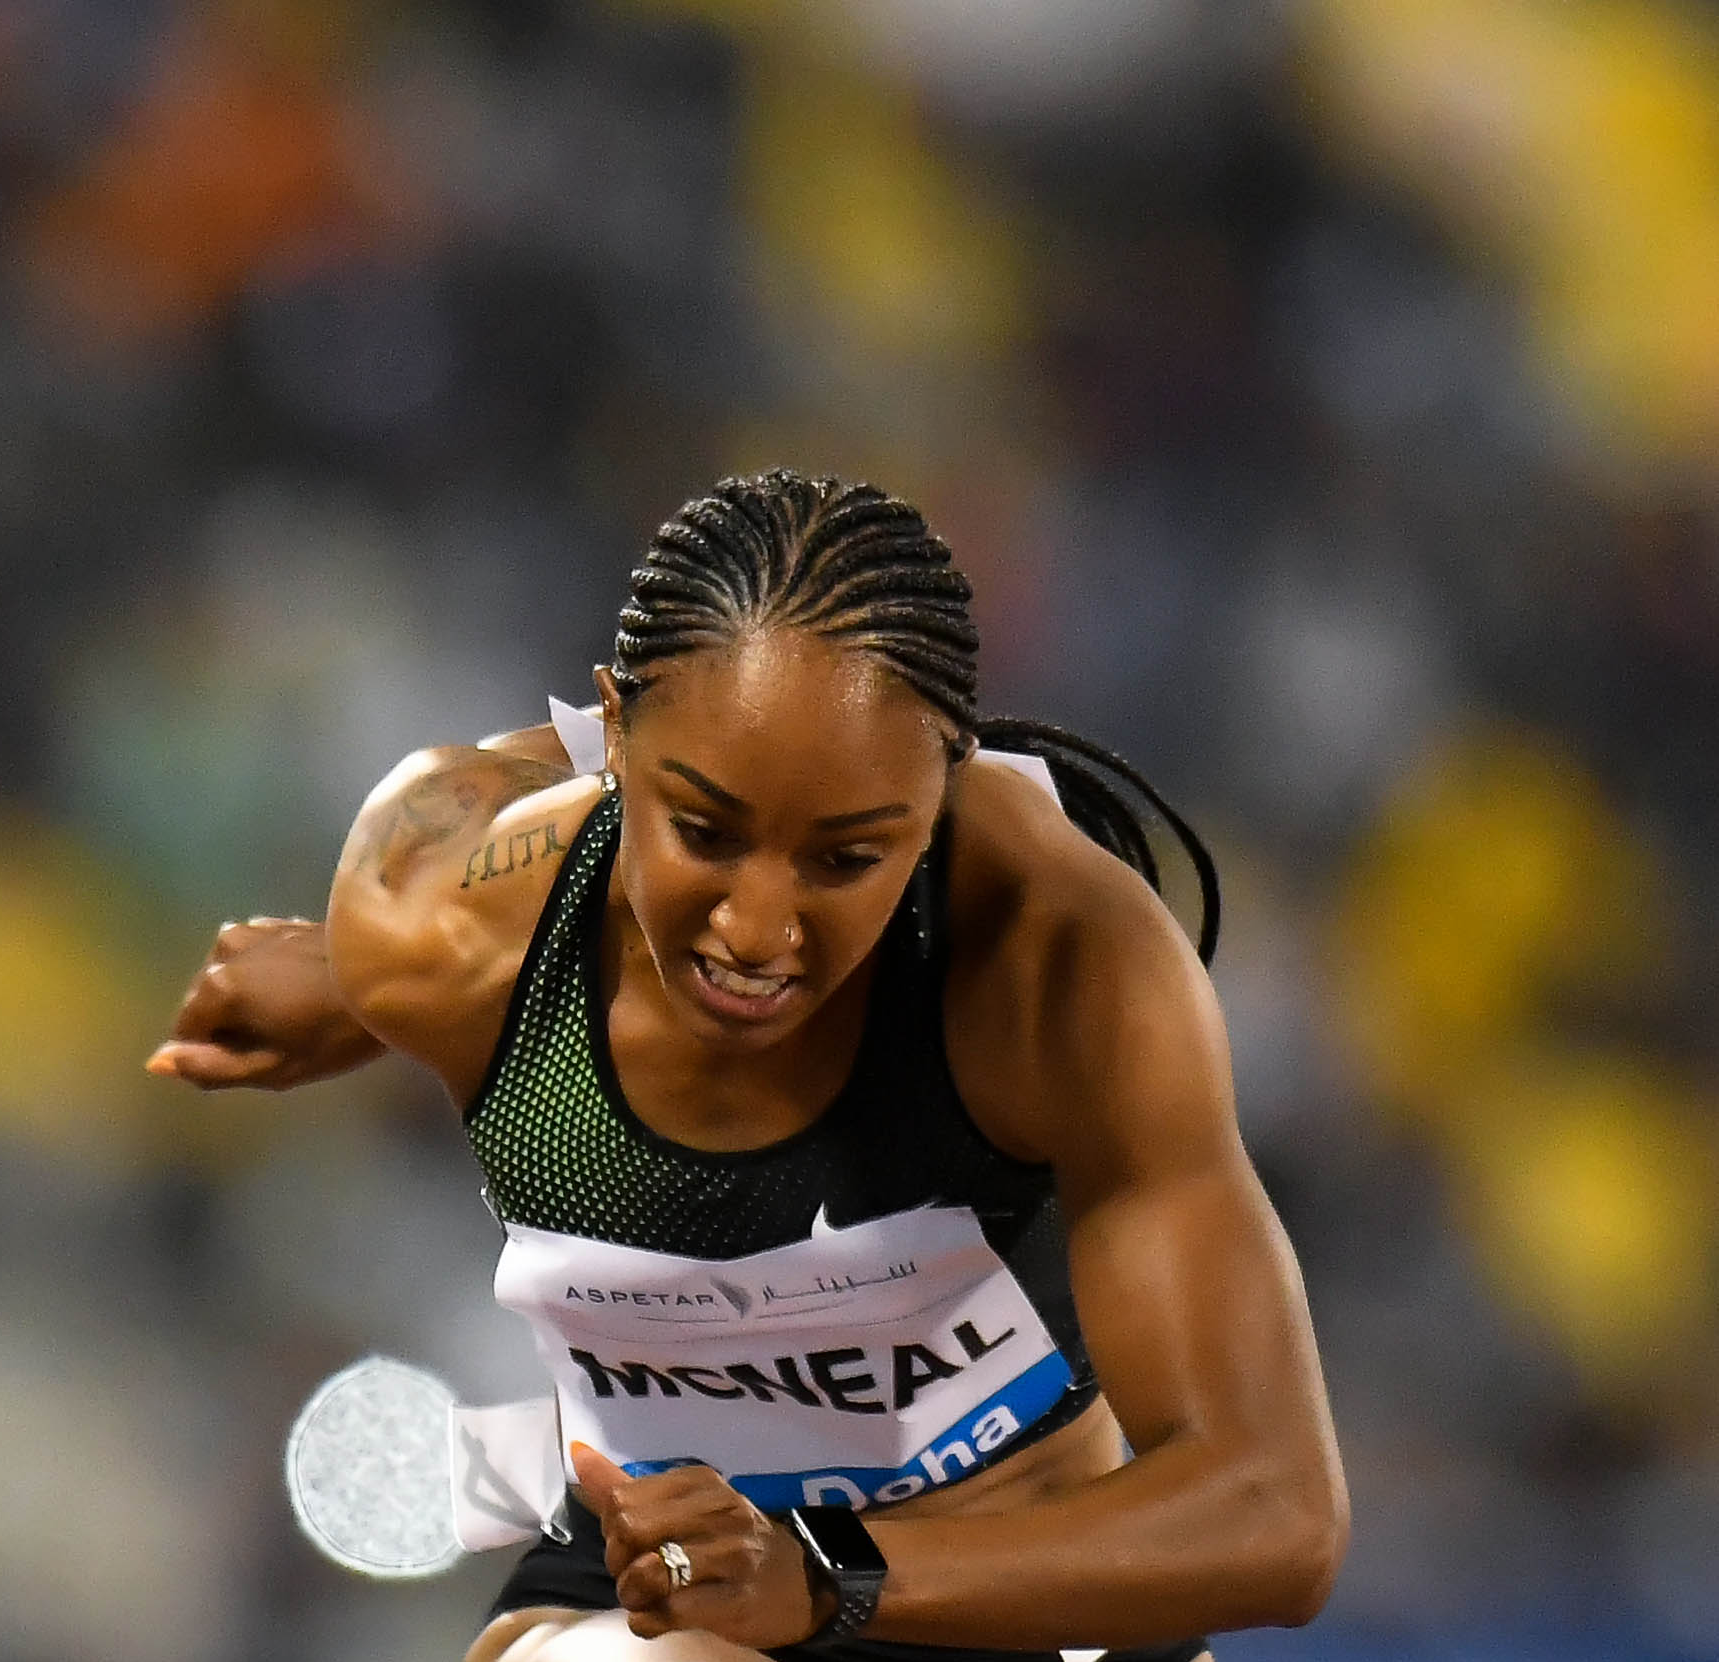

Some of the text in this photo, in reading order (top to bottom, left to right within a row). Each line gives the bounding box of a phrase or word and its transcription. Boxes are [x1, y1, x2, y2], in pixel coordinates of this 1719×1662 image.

[565, 1285, 719, 1307] ASPETAR
[568, 1319, 1017, 1415] MCNEAL
[801, 1404, 1022, 1513] Doha
